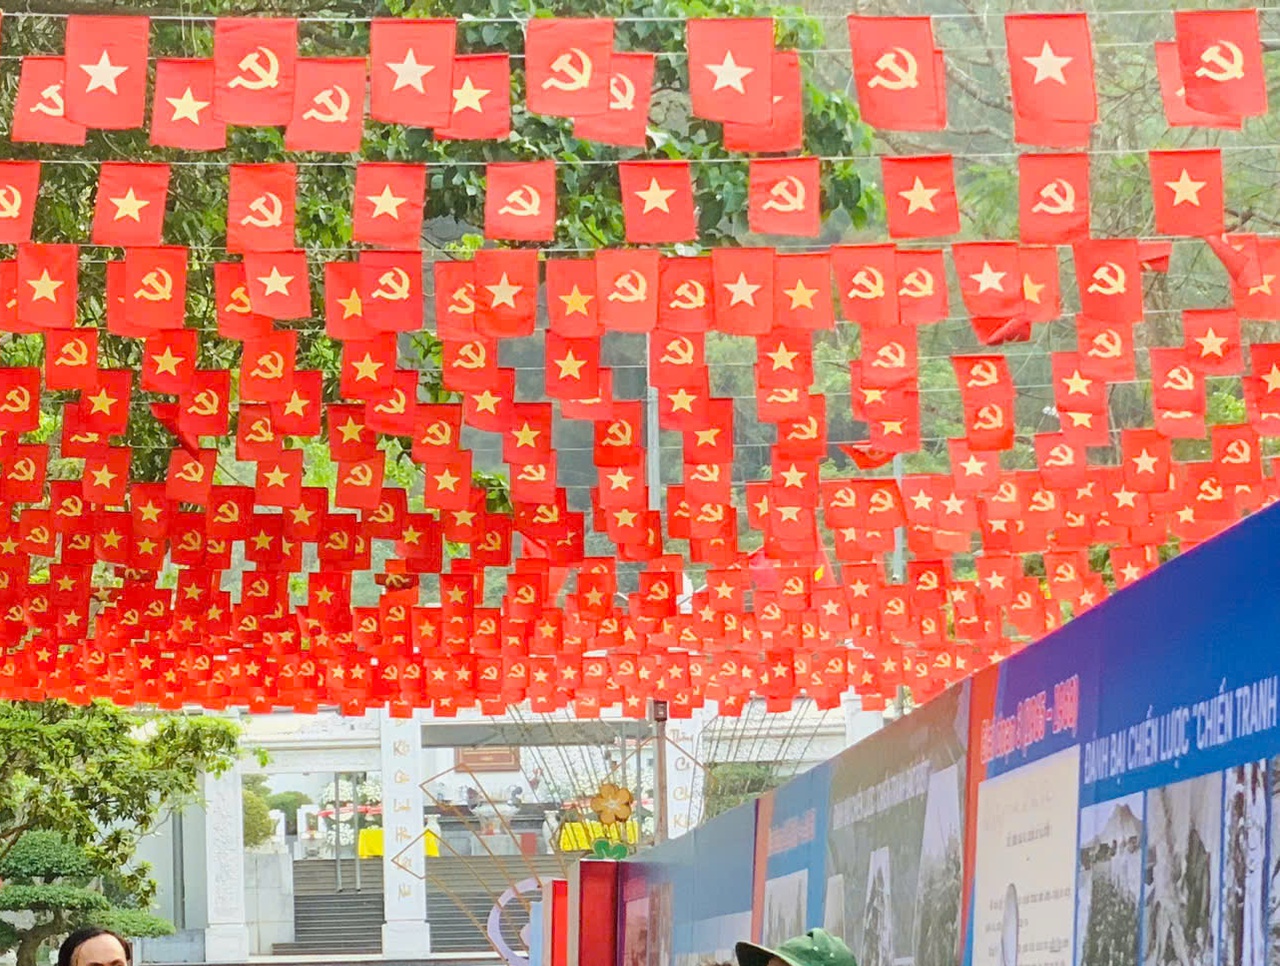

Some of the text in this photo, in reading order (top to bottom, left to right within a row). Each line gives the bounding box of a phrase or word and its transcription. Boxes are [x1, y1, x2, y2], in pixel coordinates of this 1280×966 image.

[1127, 704, 1158, 770] CHIẾN
[1160, 706, 1190, 769] LƯỢC
[1235, 674, 1278, 738] TRANH
